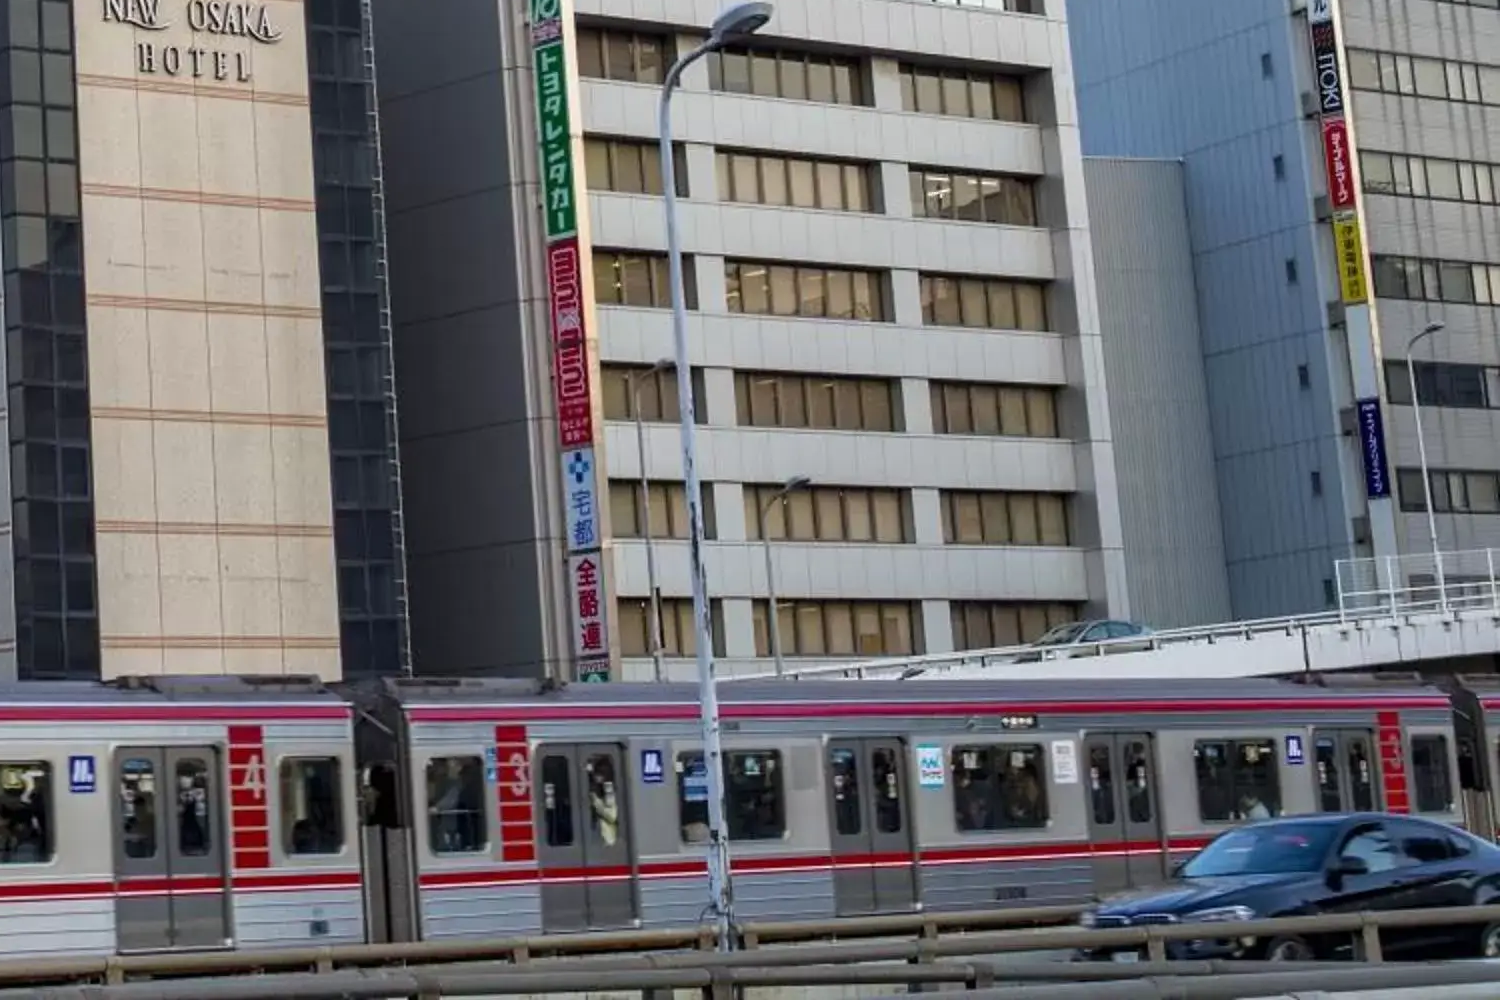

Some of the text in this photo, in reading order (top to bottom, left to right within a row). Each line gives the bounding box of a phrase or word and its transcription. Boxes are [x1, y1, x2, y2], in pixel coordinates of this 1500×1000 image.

[187, 0, 283, 44] OSAKA
[138, 44, 251, 82] HOTEL
[539, 51, 569, 229] トヨタレンタカー
[572, 490, 595, 546] 宅都
[243, 754, 263, 799] 4
[510, 752, 527, 796] 3
